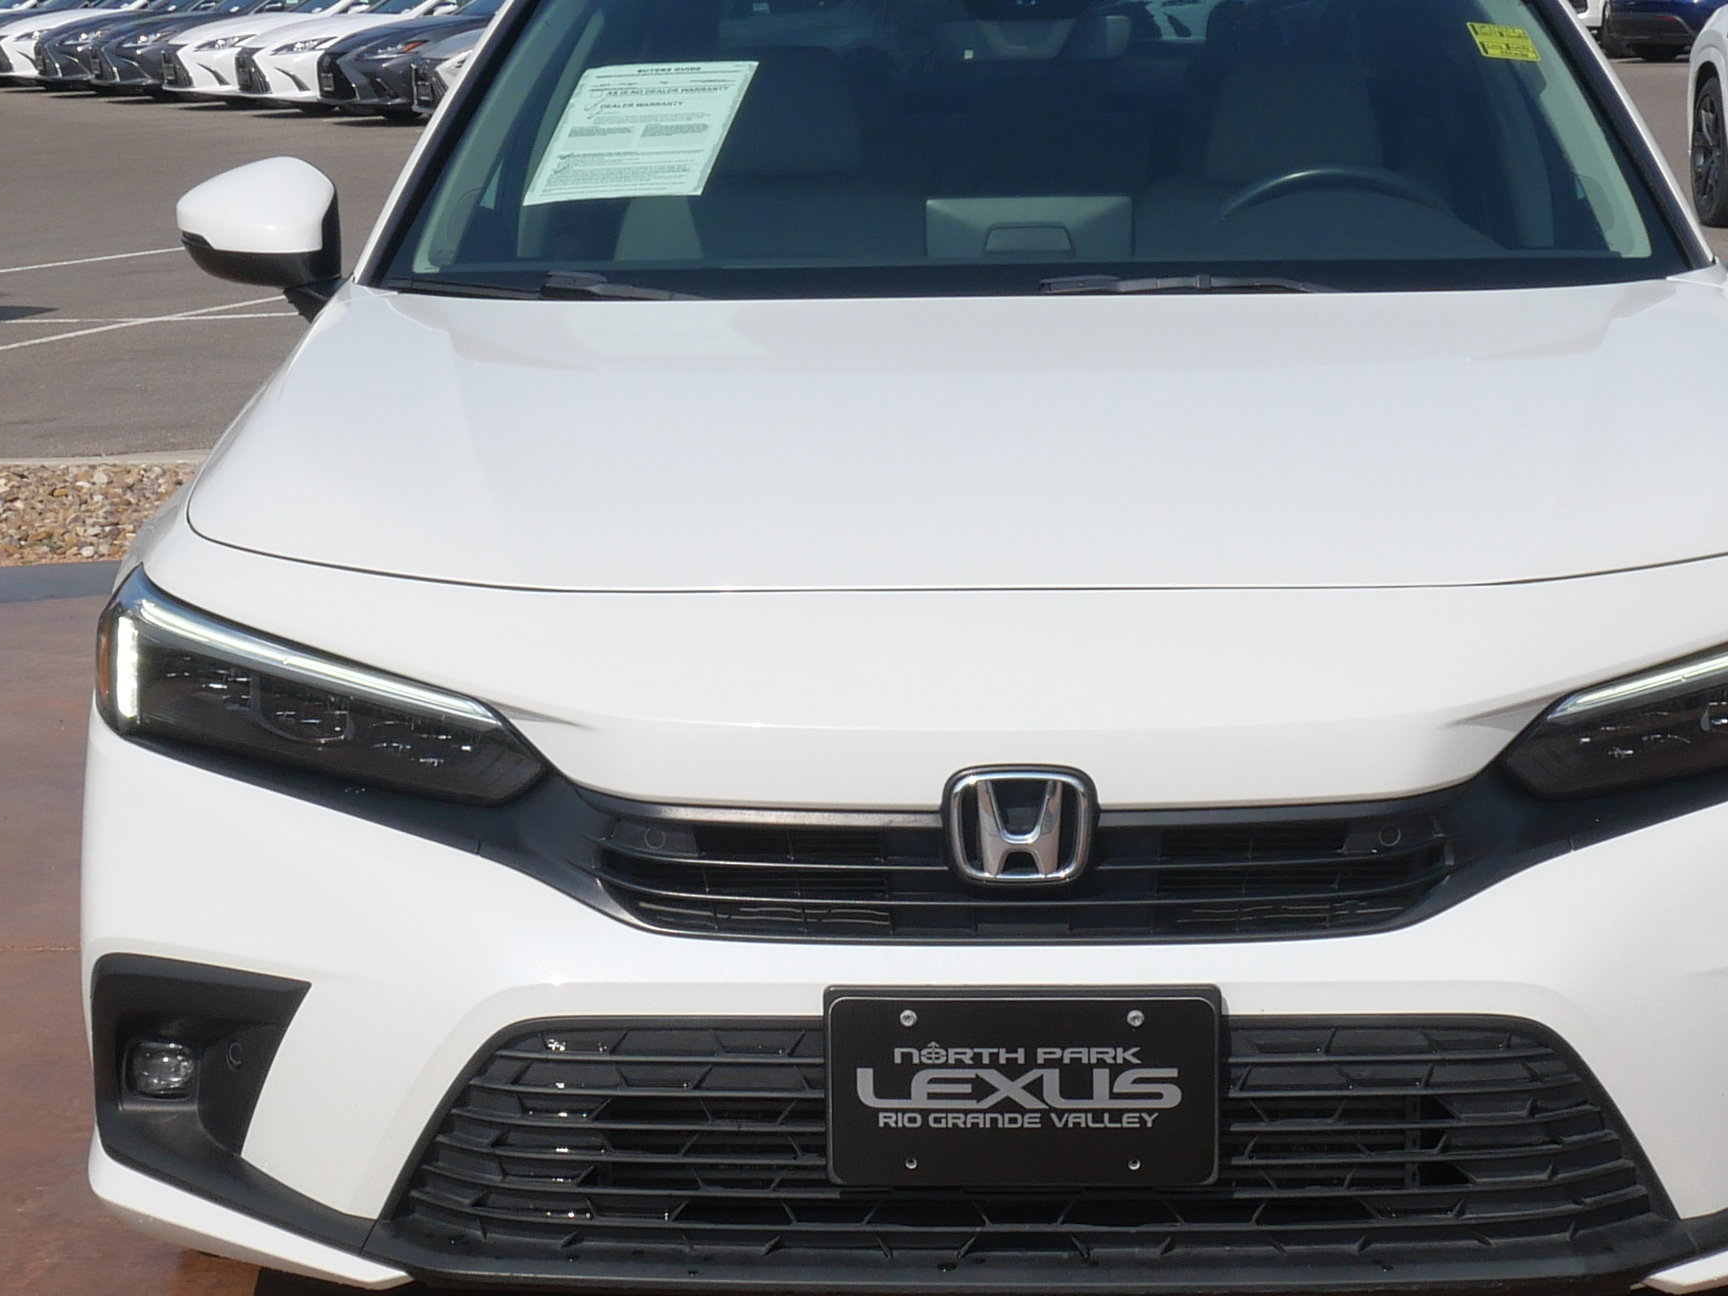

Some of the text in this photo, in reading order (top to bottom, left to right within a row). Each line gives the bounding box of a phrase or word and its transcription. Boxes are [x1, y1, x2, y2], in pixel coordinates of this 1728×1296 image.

[681, 86, 729, 94] WARRANTY
[893, 1043, 1142, 1065] NORTH PARK
[856, 1067, 1183, 1110] LEXUS
[878, 1112, 1160, 1129] RIO GRANDE VALLEY
